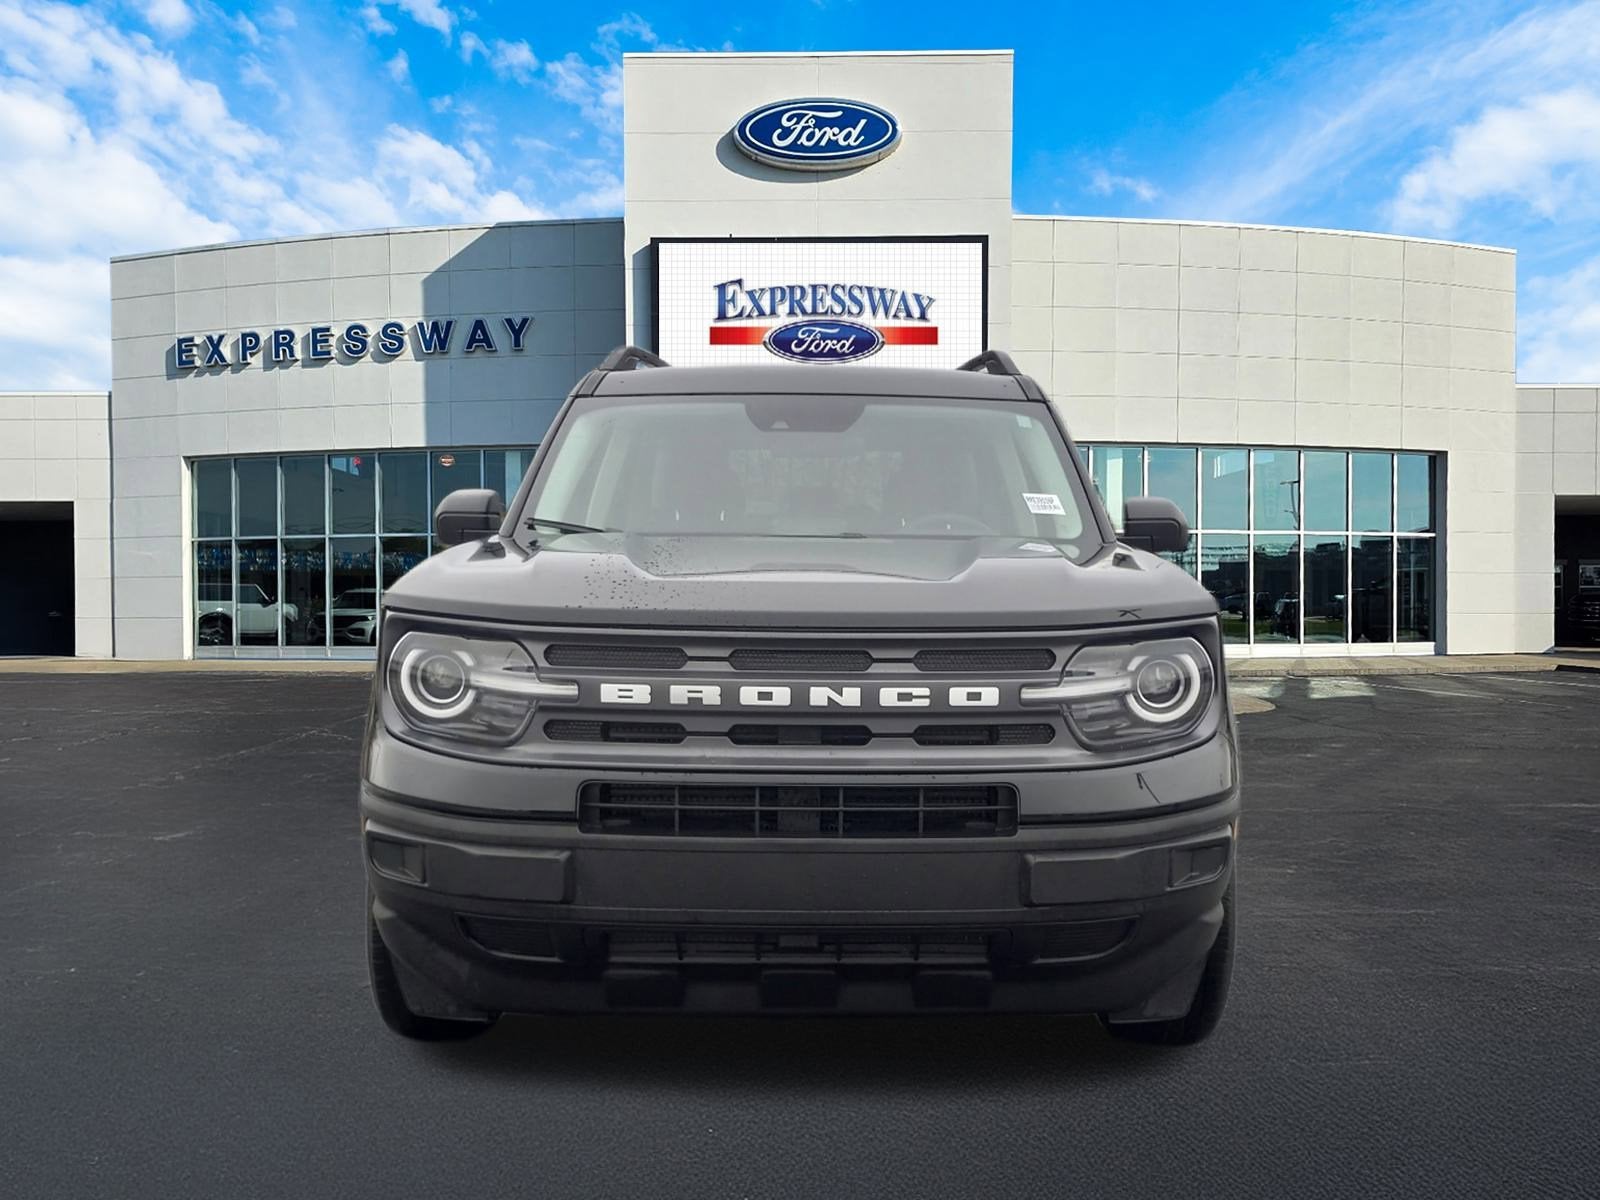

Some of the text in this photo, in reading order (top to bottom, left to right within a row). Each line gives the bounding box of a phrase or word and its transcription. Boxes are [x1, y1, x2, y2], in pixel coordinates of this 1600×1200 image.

[771, 109, 868, 149] Ford
[175, 315, 533, 368] EXPRESSWAY
[792, 325, 855, 355] Ford
[600, 683, 1000, 707] BRONCO
